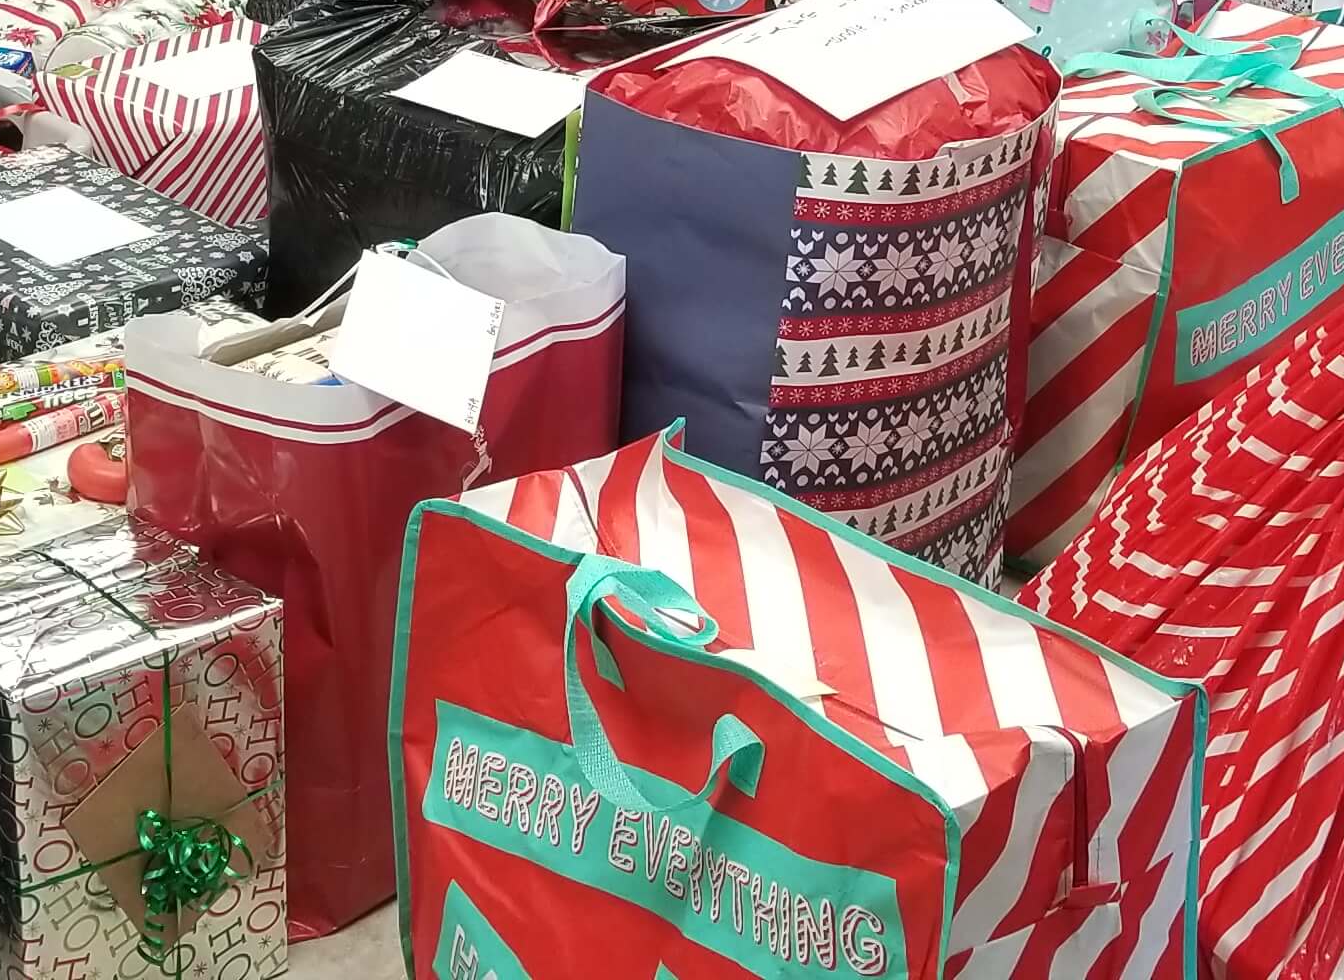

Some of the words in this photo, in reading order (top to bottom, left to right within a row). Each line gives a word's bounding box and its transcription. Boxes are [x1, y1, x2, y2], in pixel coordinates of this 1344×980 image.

[1190, 273, 1294, 369] MERRY
[42, 387, 99, 409] Trees
[443, 737, 601, 853] MERRY
[608, 806, 890, 975] EVERYTHING
